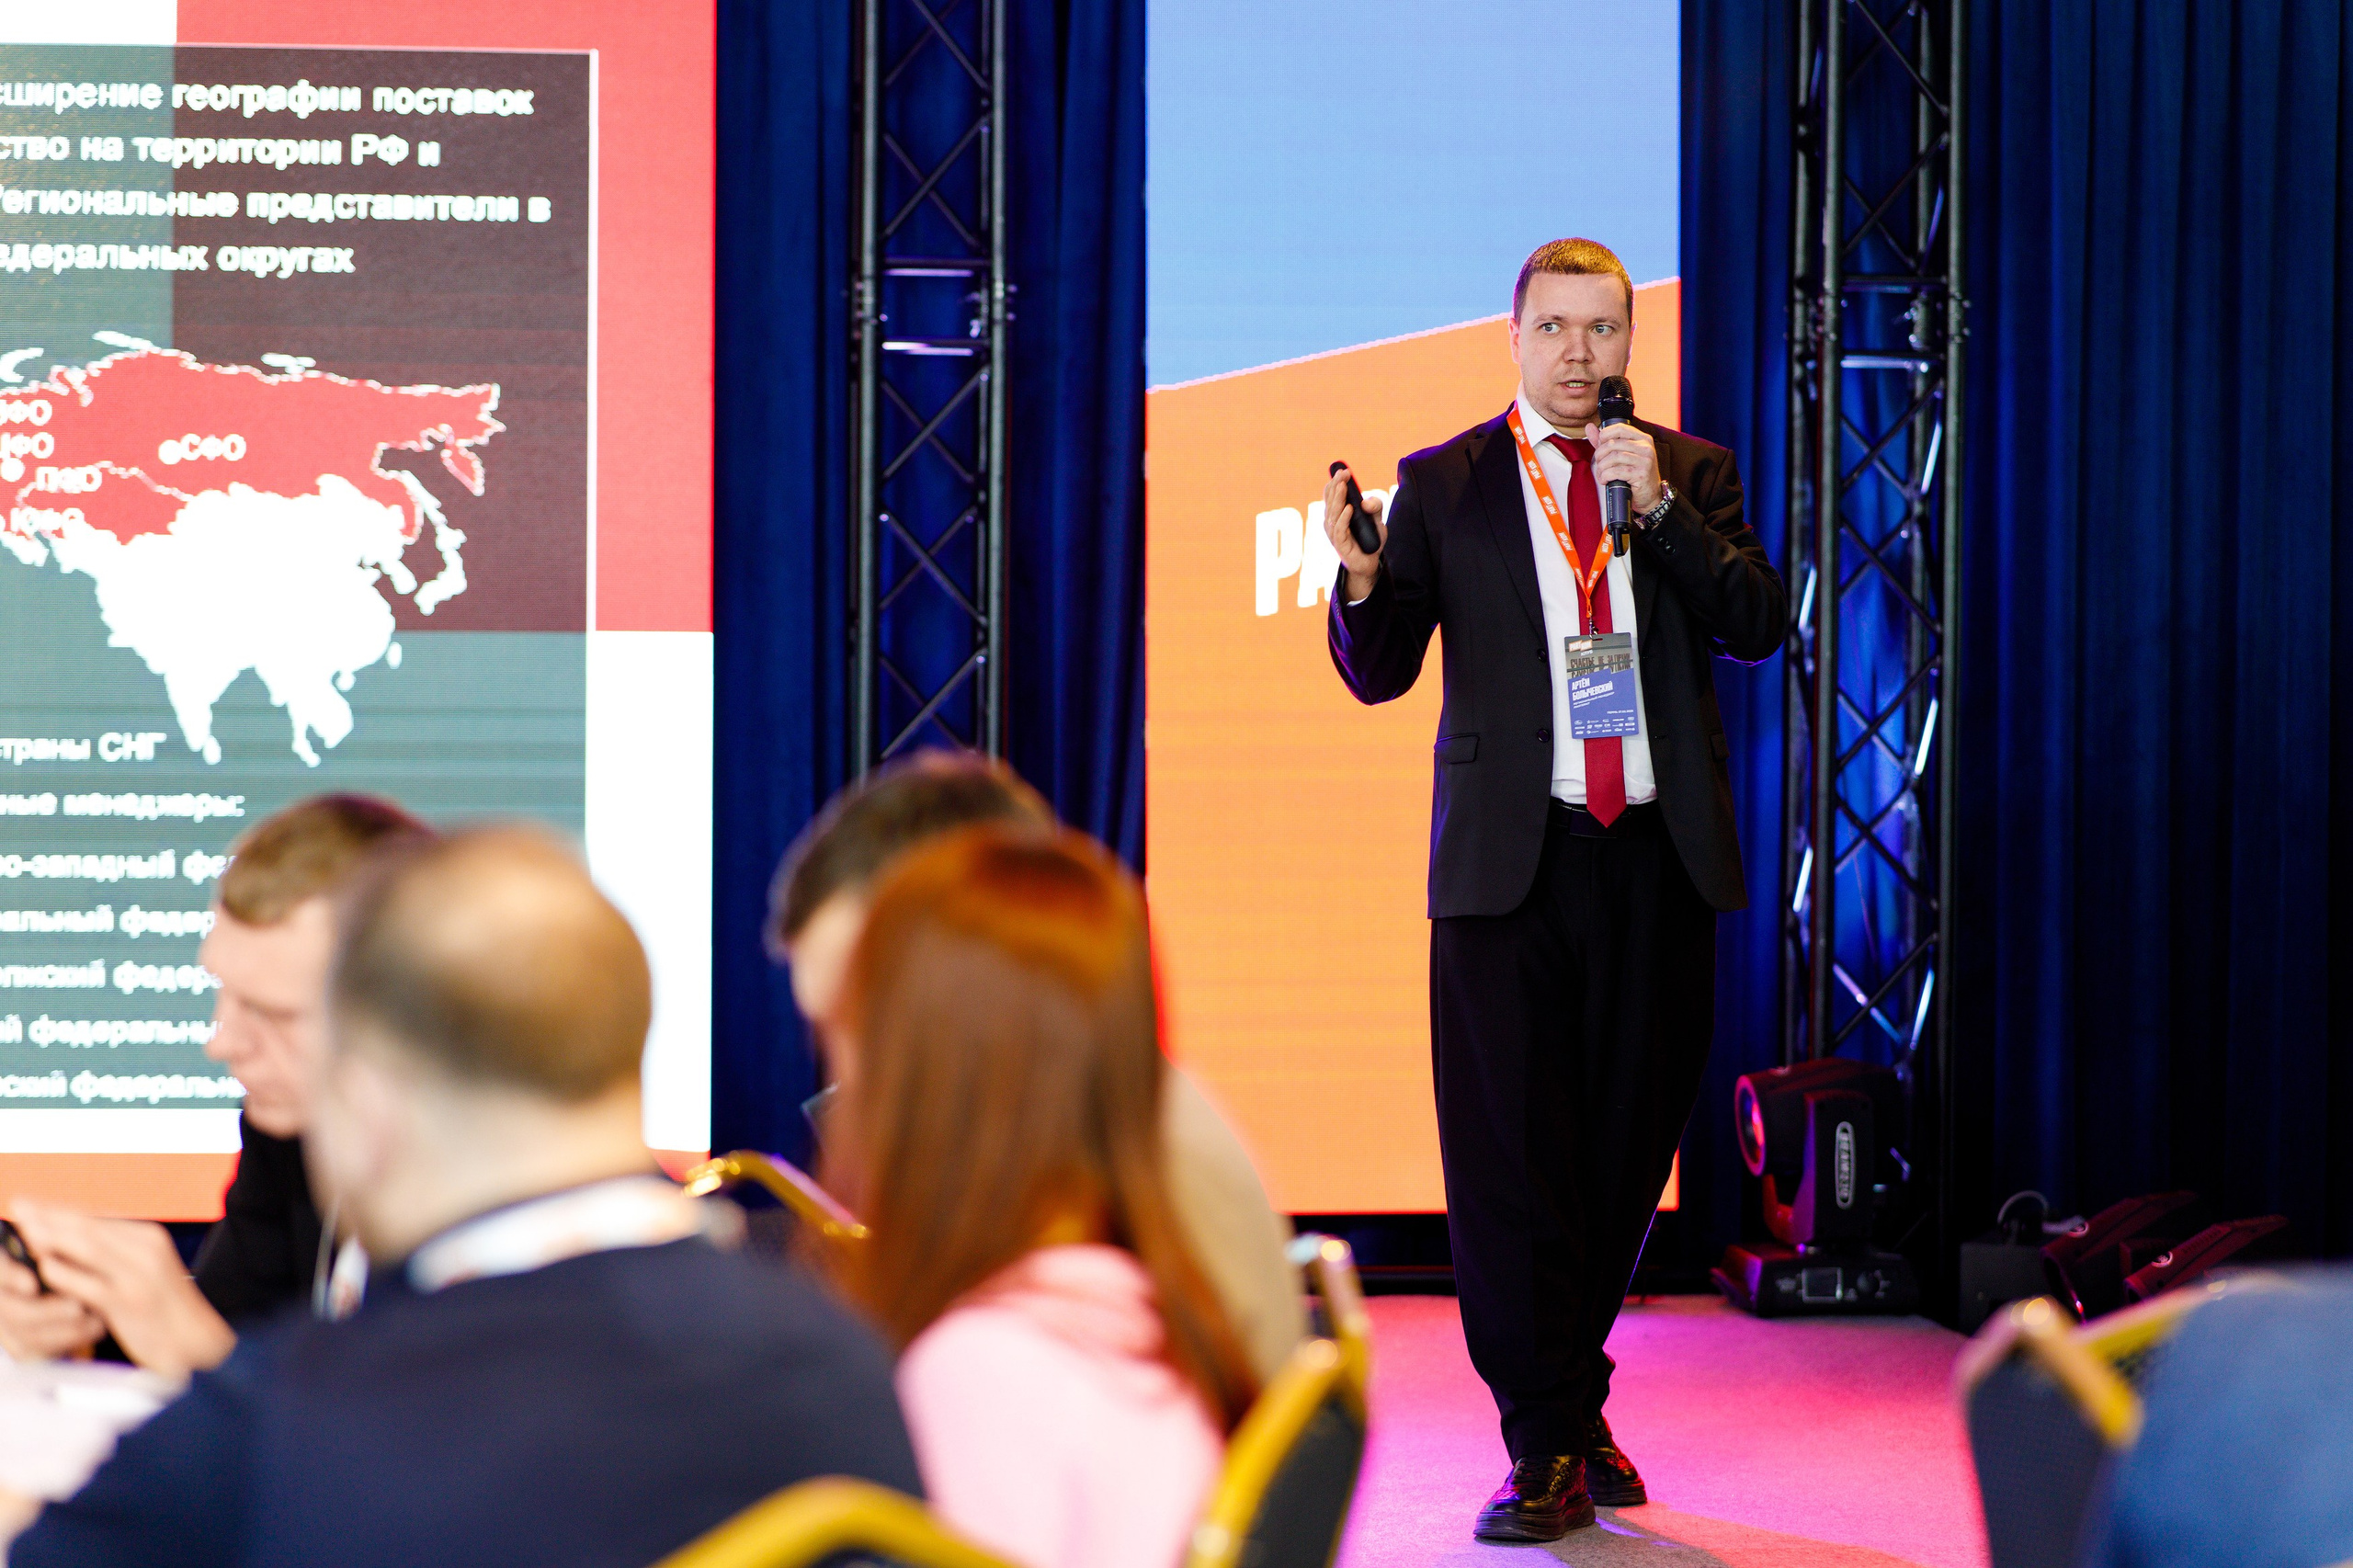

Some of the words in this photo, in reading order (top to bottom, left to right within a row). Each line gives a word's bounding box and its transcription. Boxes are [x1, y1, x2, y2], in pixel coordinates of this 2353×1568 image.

[0, 83, 164, 115] ширение
[172, 80, 361, 119] географии
[372, 86, 534, 117] поставок
[81, 136, 124, 161] на
[132, 137, 341, 170] территории
[352, 134, 408, 165] РФ
[419, 142, 440, 166] и
[0, 184, 238, 218] егиональные
[247, 192, 519, 224] представители
[529, 197, 551, 222] в
[217, 246, 356, 278] округах
[0, 737, 91, 766] траны
[98, 732, 167, 762] СНГ
[63, 793, 245, 824] менеджеры:
